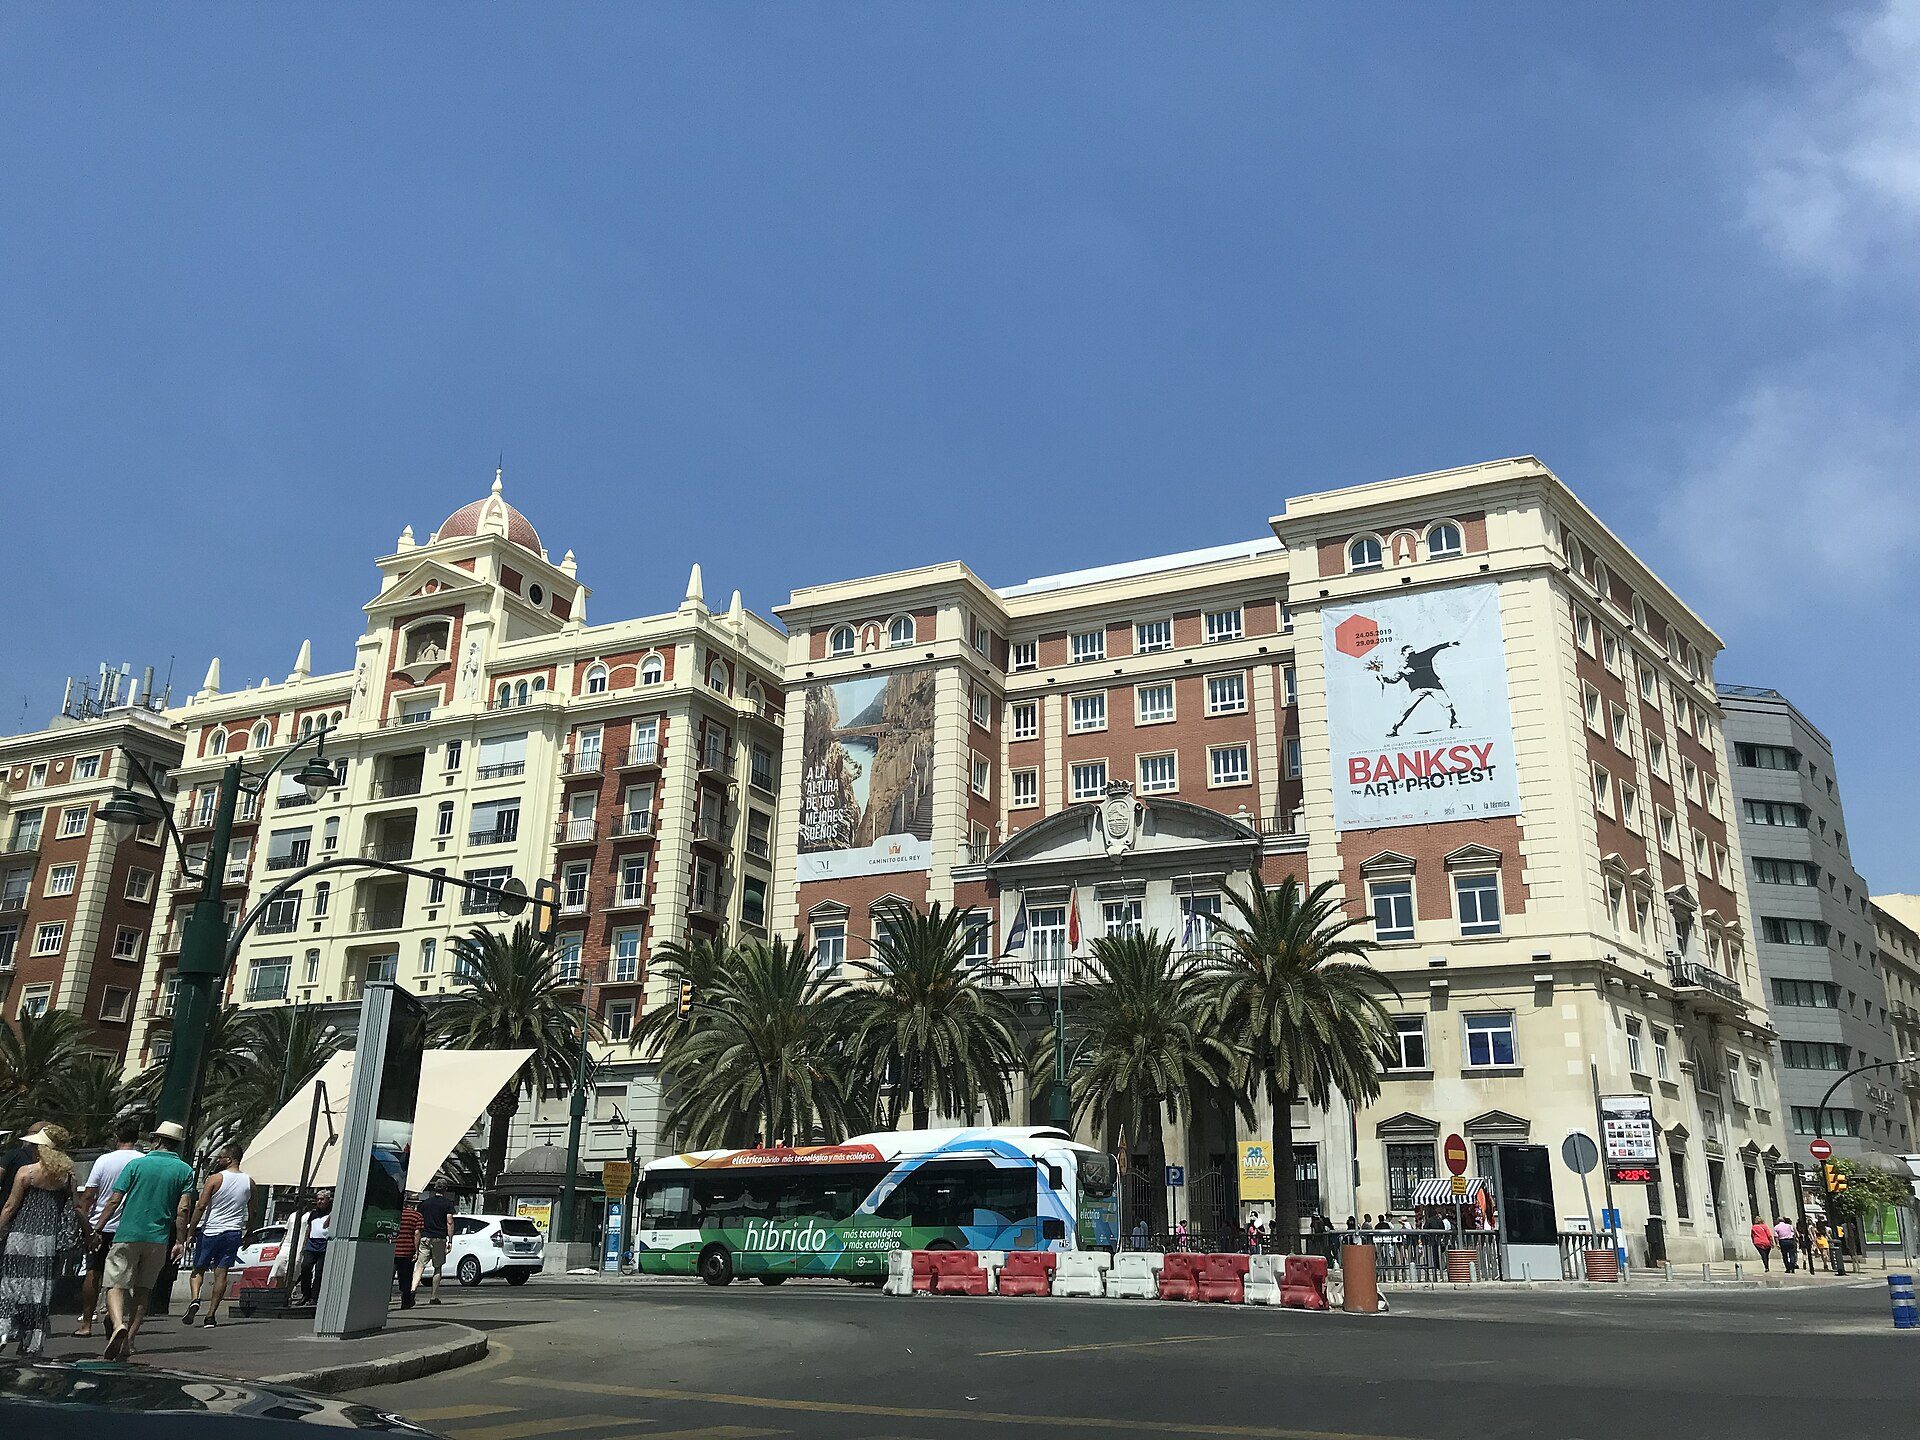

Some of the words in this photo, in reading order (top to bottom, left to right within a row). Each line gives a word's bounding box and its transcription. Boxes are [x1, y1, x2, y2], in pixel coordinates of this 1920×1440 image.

[1355, 629, 1392, 639] 24.05.2019
[1356, 637, 1393, 647] 29.09.2019
[1348, 742, 1494, 785] BANKSY
[807, 766, 814, 781] A
[815, 765, 827, 779] LA
[806, 778, 840, 796] ALTURA
[1363, 778, 1400, 798] ART
[1405, 764, 1497, 793] PROTEST
[805, 796, 818, 811] DE
[818, 794, 836, 810] TUS
[1483, 801, 1489, 810] la
[1489, 800, 1511, 809] térmica
[804, 808, 845, 826] MEJORES
[868, 857, 896, 865] CAMINITO
[731, 1154, 762, 1165] eléctrico
[781, 1154, 794, 1163] más
[794, 1152, 828, 1163] tecnológico
[833, 1152, 846, 1161] más
[846, 1151, 876, 1162] ecológico
[1243, 1156, 1269, 1168] MVA
[1168, 1168, 1181, 1185] P
[743, 1219, 827, 1251] híbrido
[842, 1230, 859, 1239] más
[859, 1229, 903, 1240] tecnológico
[849, 1239, 864, 1250] más
[864, 1240, 901, 1251] ecológico
